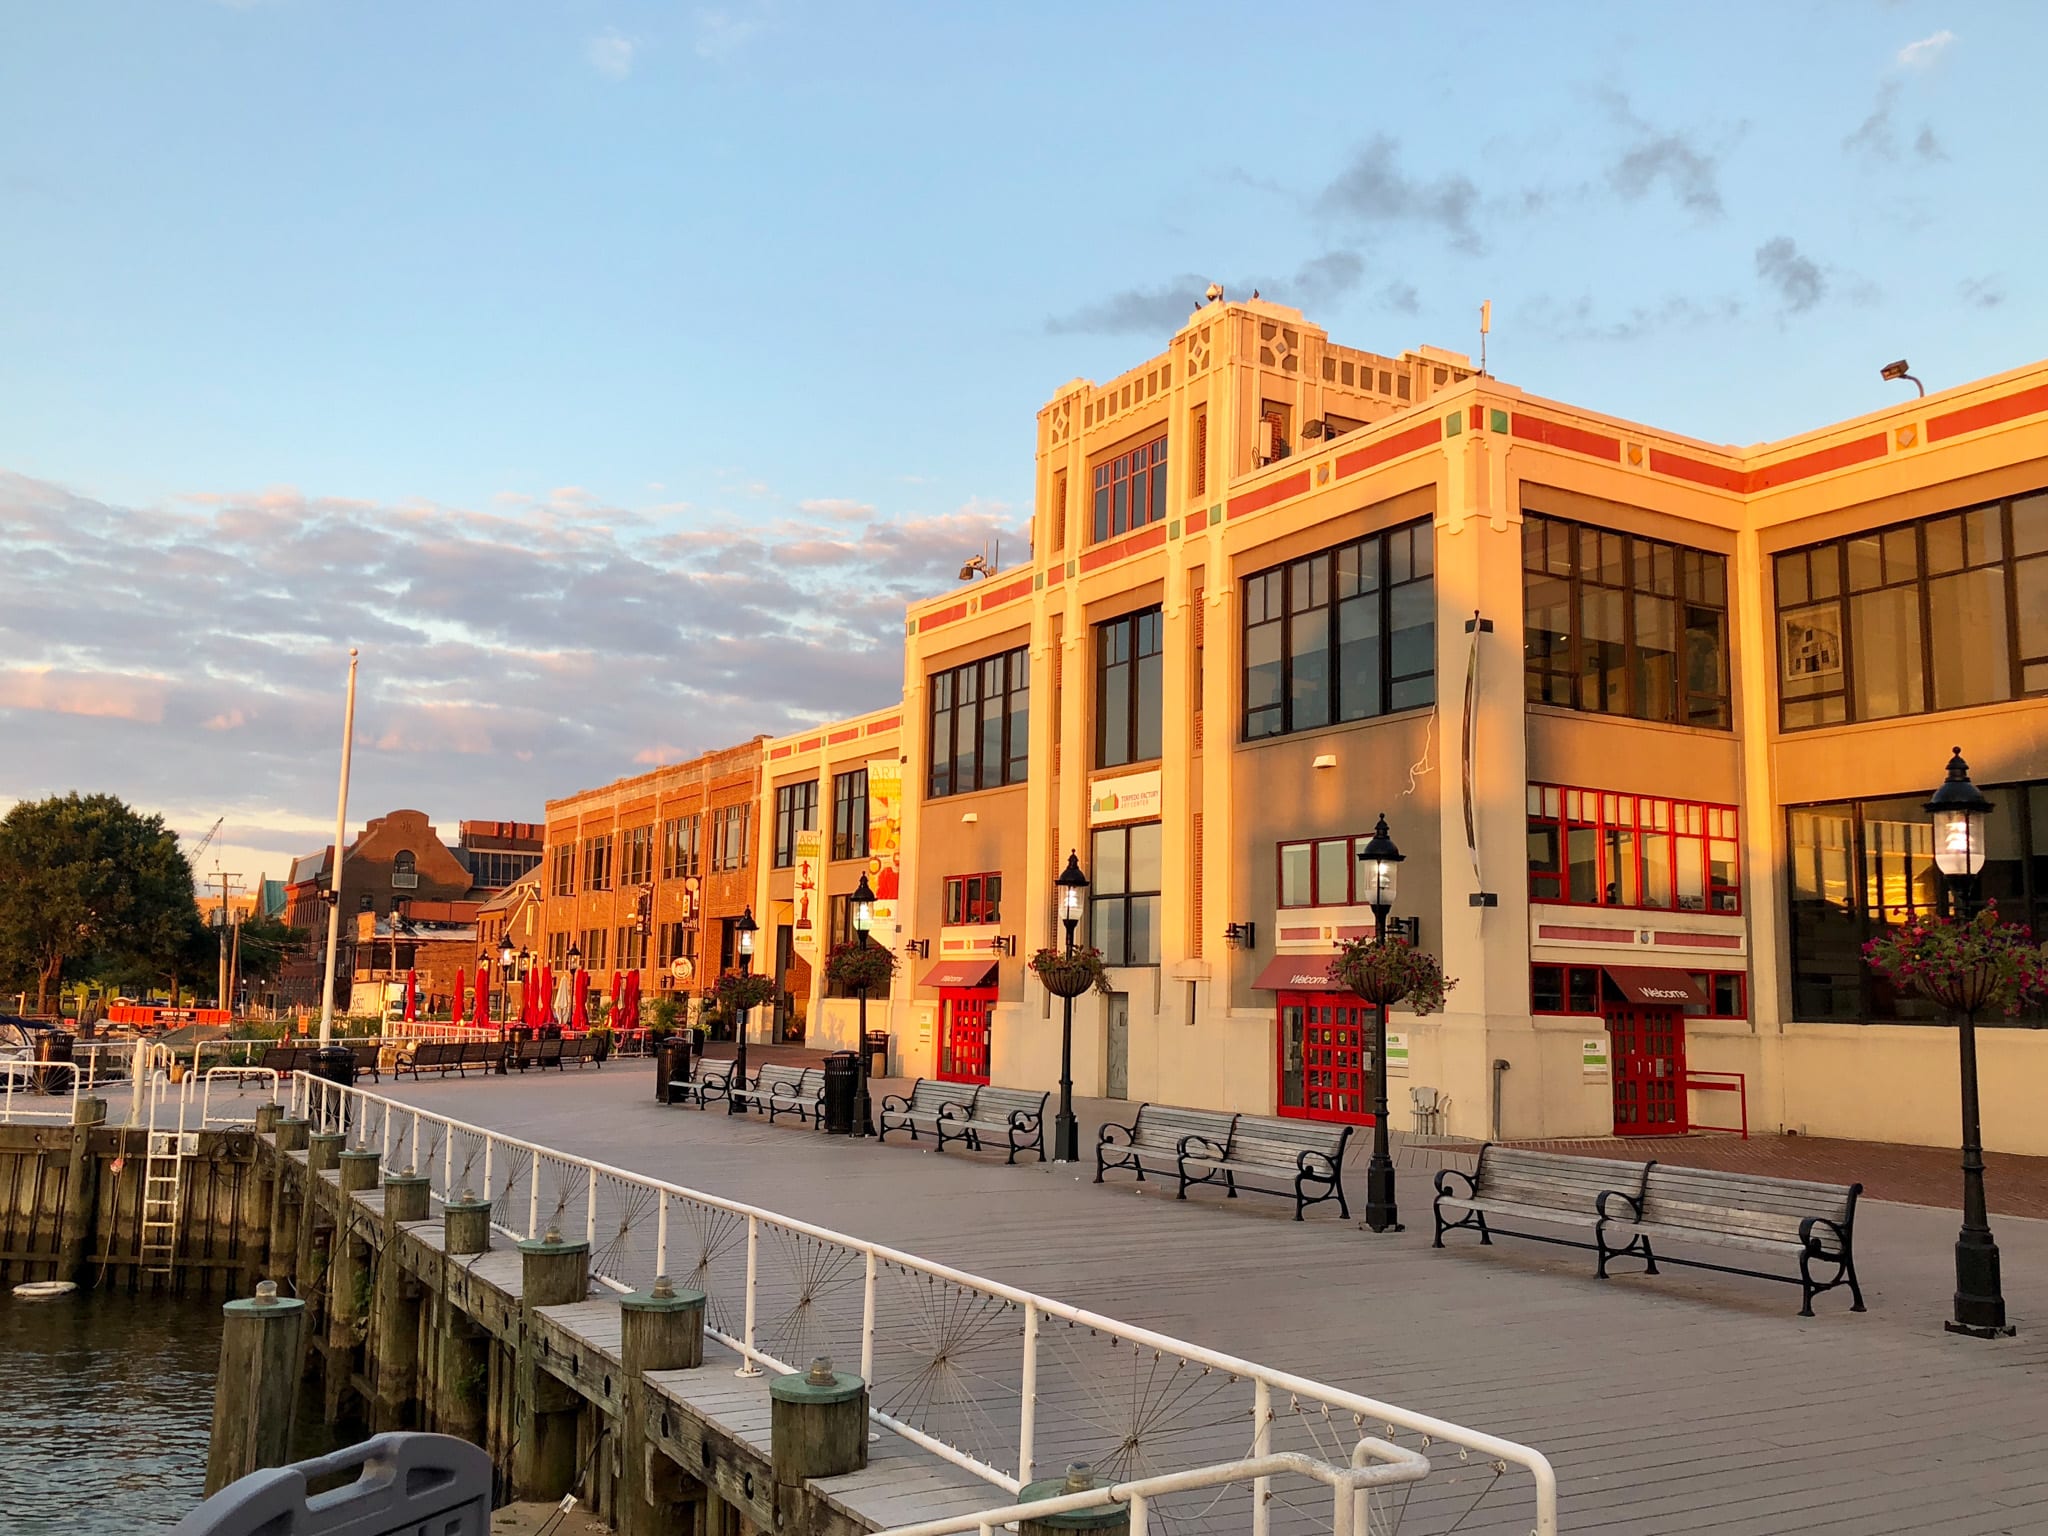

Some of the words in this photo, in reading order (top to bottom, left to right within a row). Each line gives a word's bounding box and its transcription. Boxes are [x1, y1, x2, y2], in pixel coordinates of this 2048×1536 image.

[799, 835, 820, 845] ART
[1290, 974, 1330, 985] Welcome
[1638, 987, 1689, 999] Welcome
